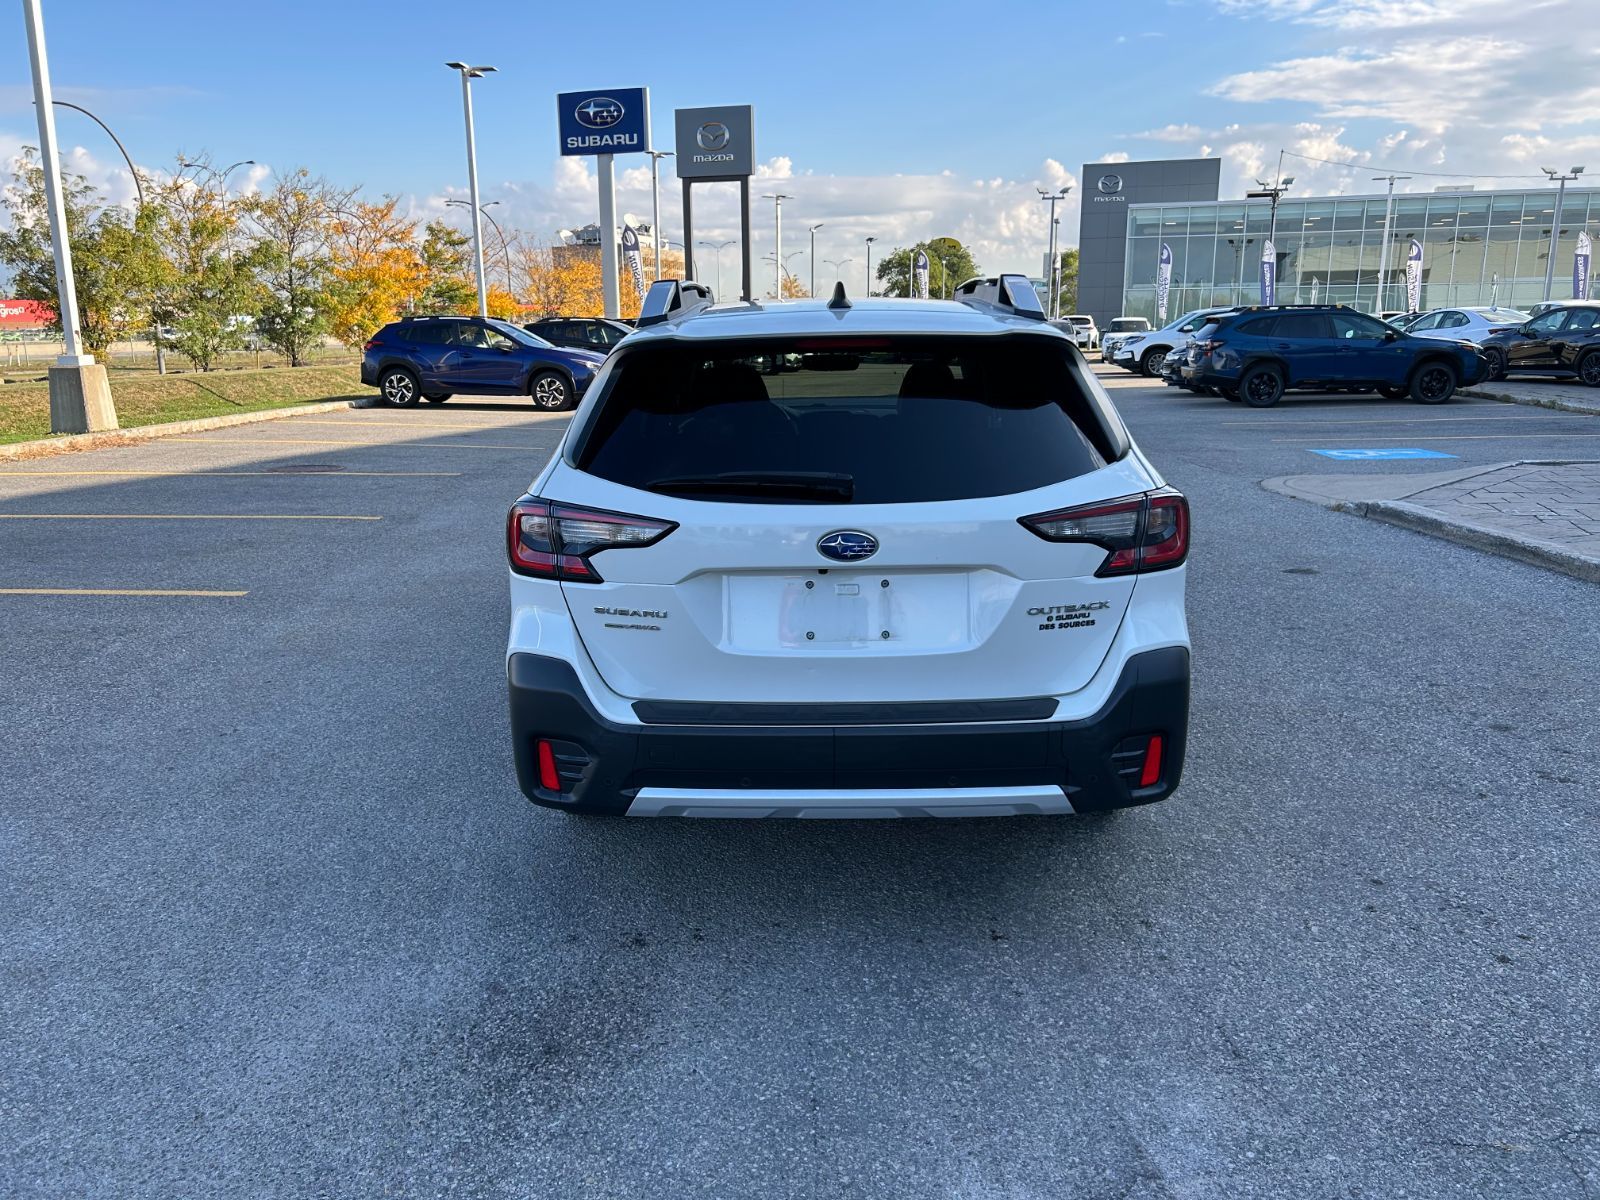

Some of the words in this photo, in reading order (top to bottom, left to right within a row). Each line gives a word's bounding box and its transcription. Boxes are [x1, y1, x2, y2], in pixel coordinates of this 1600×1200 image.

[567, 133, 638, 149] SUBARU
[693, 153, 734, 163] mazda
[593, 606, 668, 619] SUBARU
[1026, 599, 1111, 616] OUTBACK
[1055, 612, 1091, 622] SUBARU
[1039, 623, 1056, 632] DES
[1058, 619, 1096, 630] SOURCES
